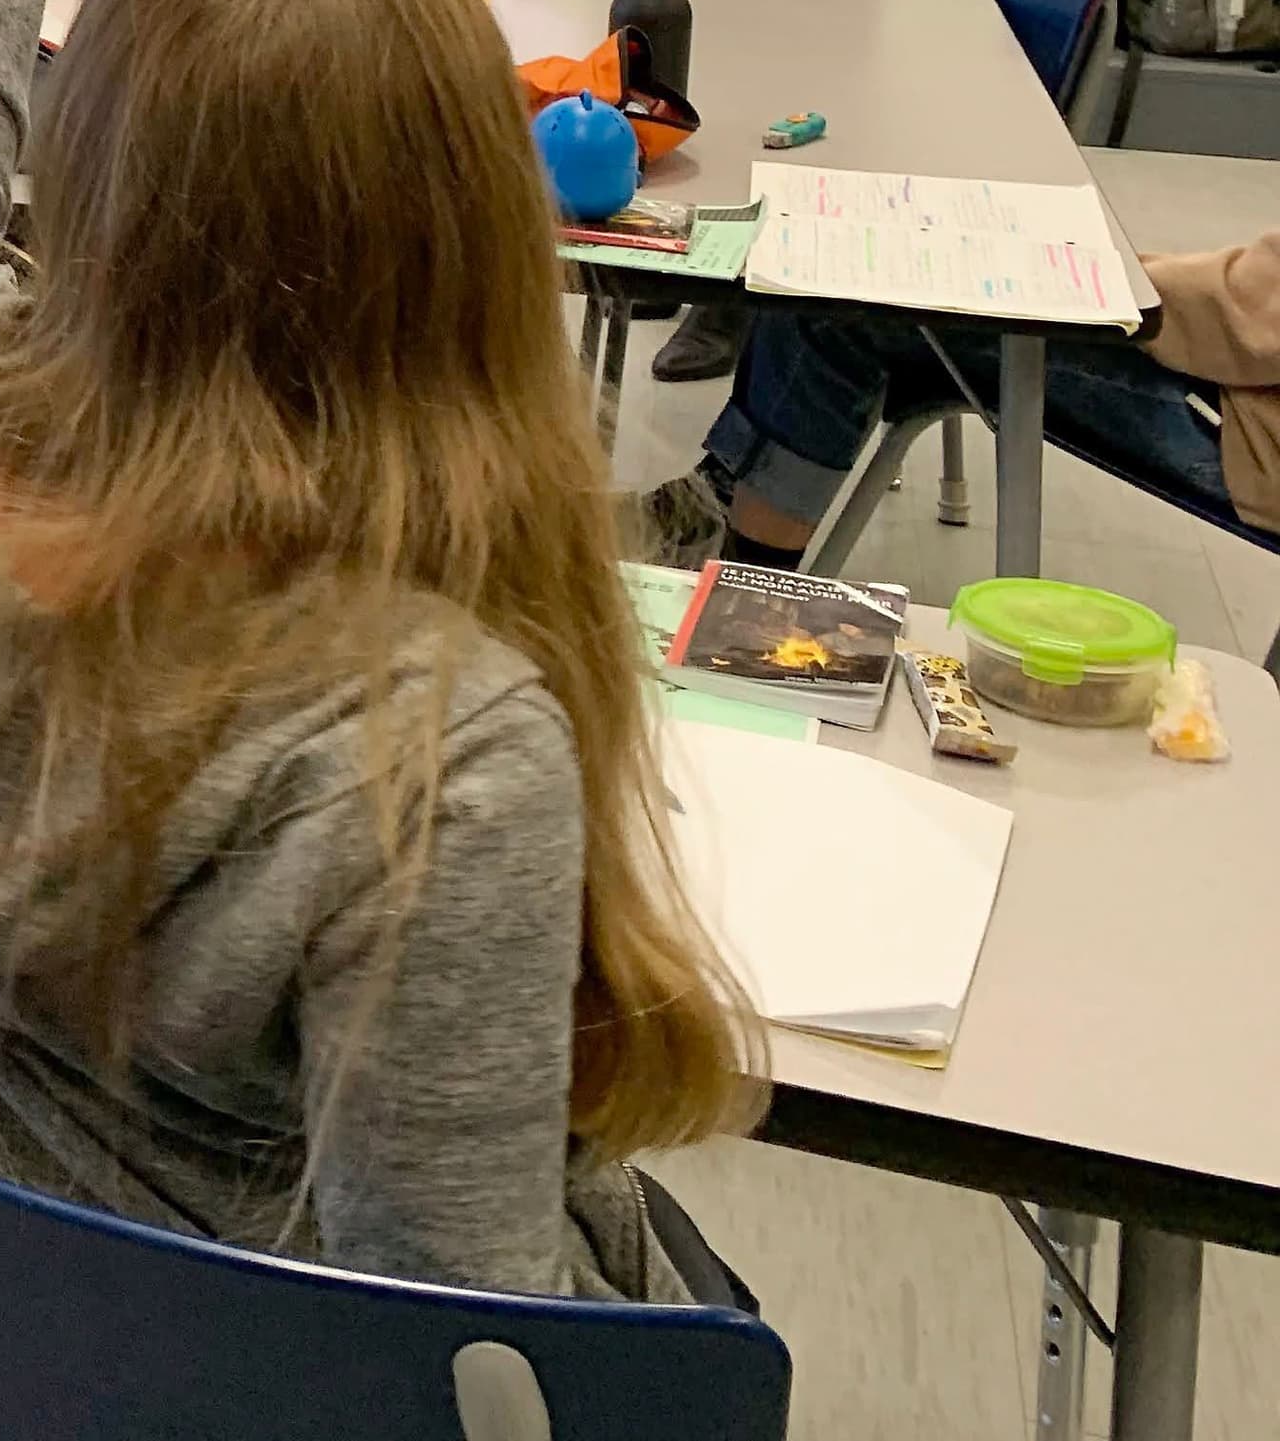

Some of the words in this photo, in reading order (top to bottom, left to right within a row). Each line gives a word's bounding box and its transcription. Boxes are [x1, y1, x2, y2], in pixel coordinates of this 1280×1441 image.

[720, 573, 747, 584] UN
[750, 577, 794, 593] NOIR
[797, 588, 844, 602] AUSSI
